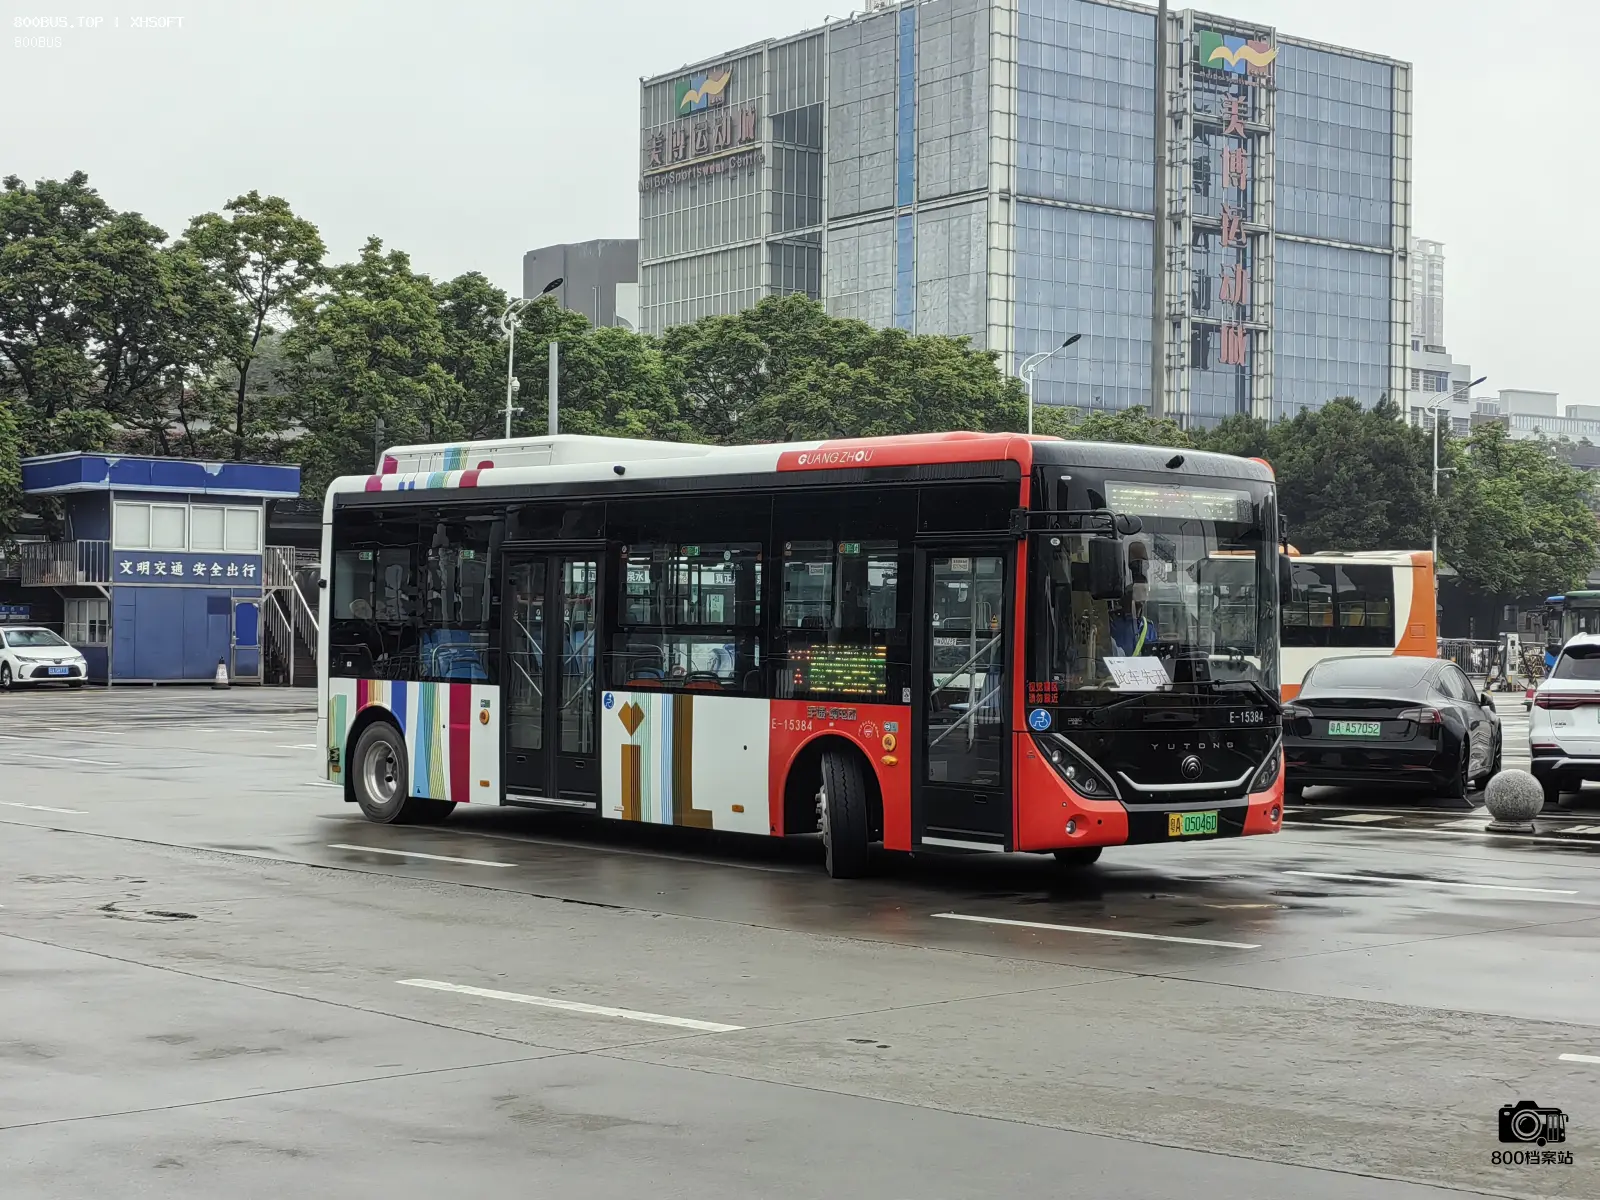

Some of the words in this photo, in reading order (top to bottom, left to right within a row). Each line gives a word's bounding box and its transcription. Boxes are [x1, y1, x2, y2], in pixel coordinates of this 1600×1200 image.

[647, 106, 758, 168] 美博运动城
[1220, 92, 1248, 367] 美博运动城
[119, 560, 185, 577] 文明交通
[192, 562, 257, 578] 安全出行
[1114, 669, 1168, 686] 此车先开
[771, 718, 813, 732] E-15384
[1229, 711, 1264, 724] E-15384
[1150, 741, 1234, 750] YUTONG
